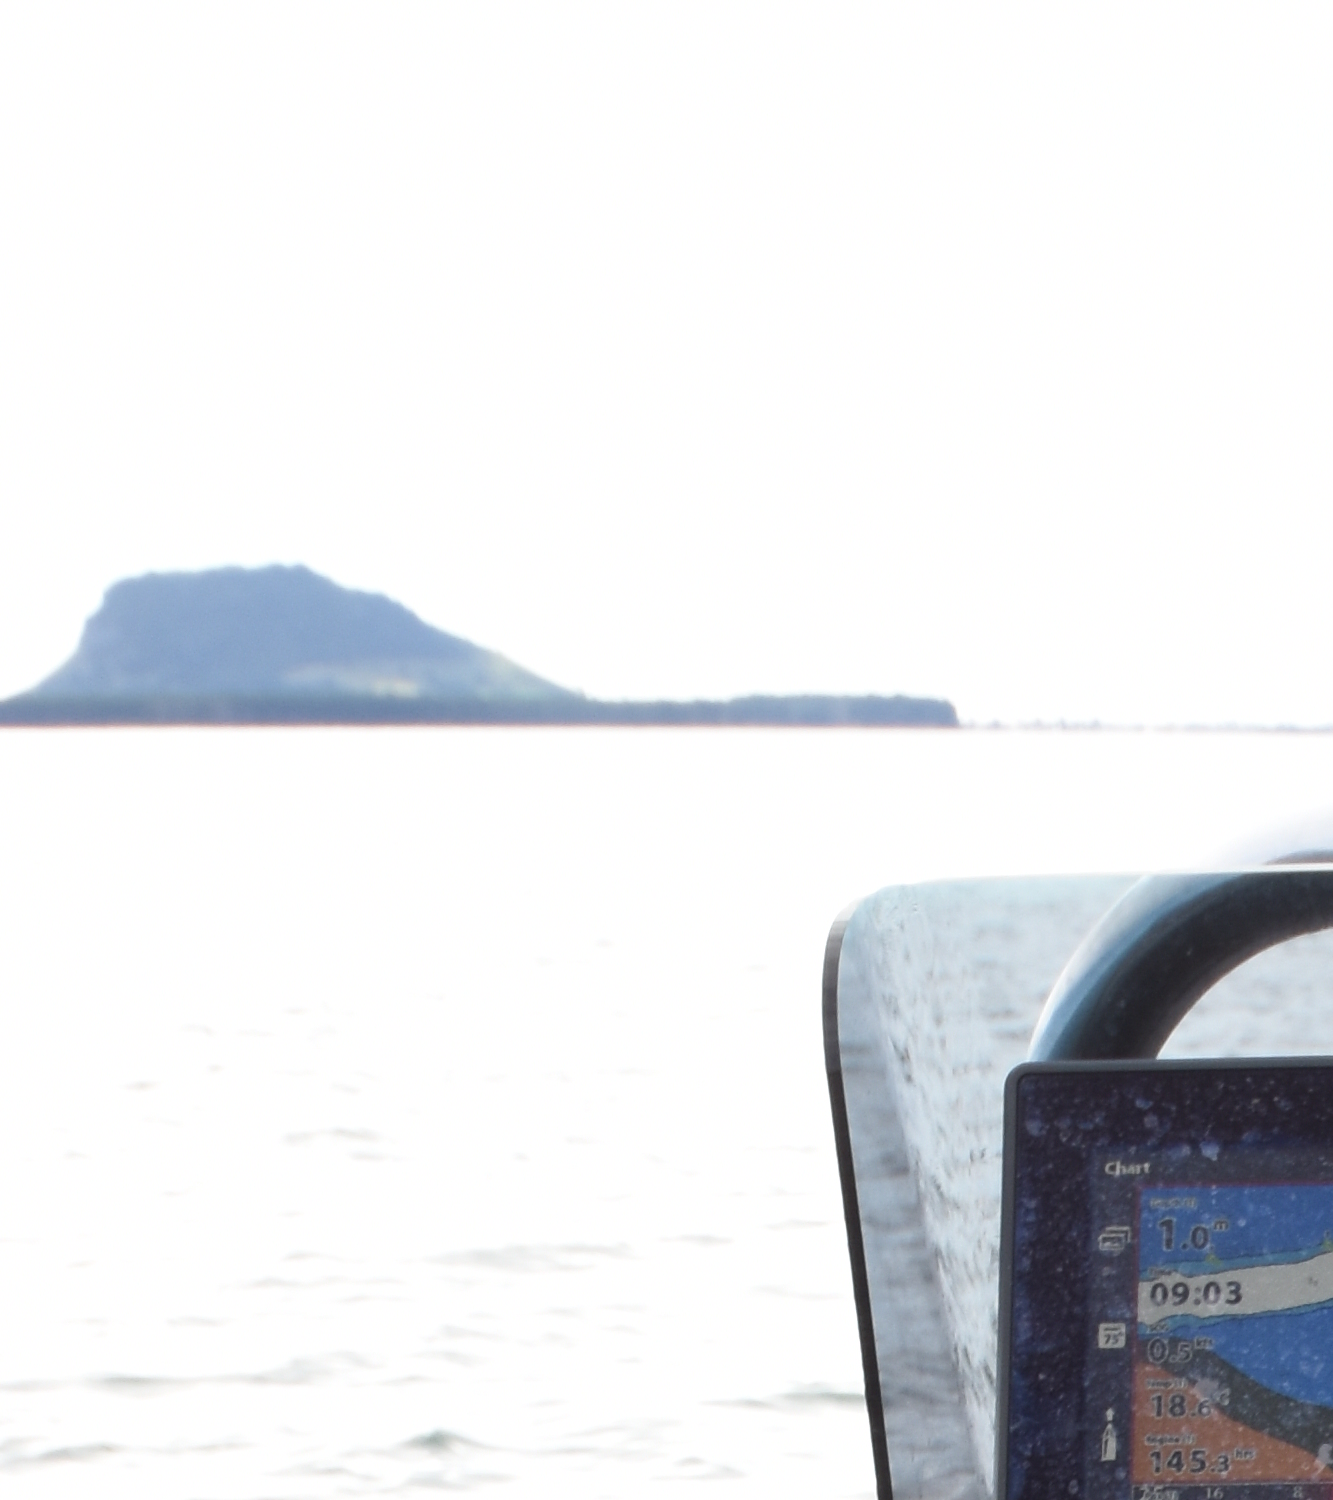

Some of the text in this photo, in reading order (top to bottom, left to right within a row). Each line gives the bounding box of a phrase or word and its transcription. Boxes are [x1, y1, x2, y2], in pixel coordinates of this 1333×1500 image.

[1104, 1161, 1151, 1176] Chart
[1158, 1217, 1209, 1250] 1.0
[1150, 1280, 1243, 1306] 09:03
[1150, 1394, 1211, 1418] 18.6
[1150, 1450, 1230, 1474] 145.3
